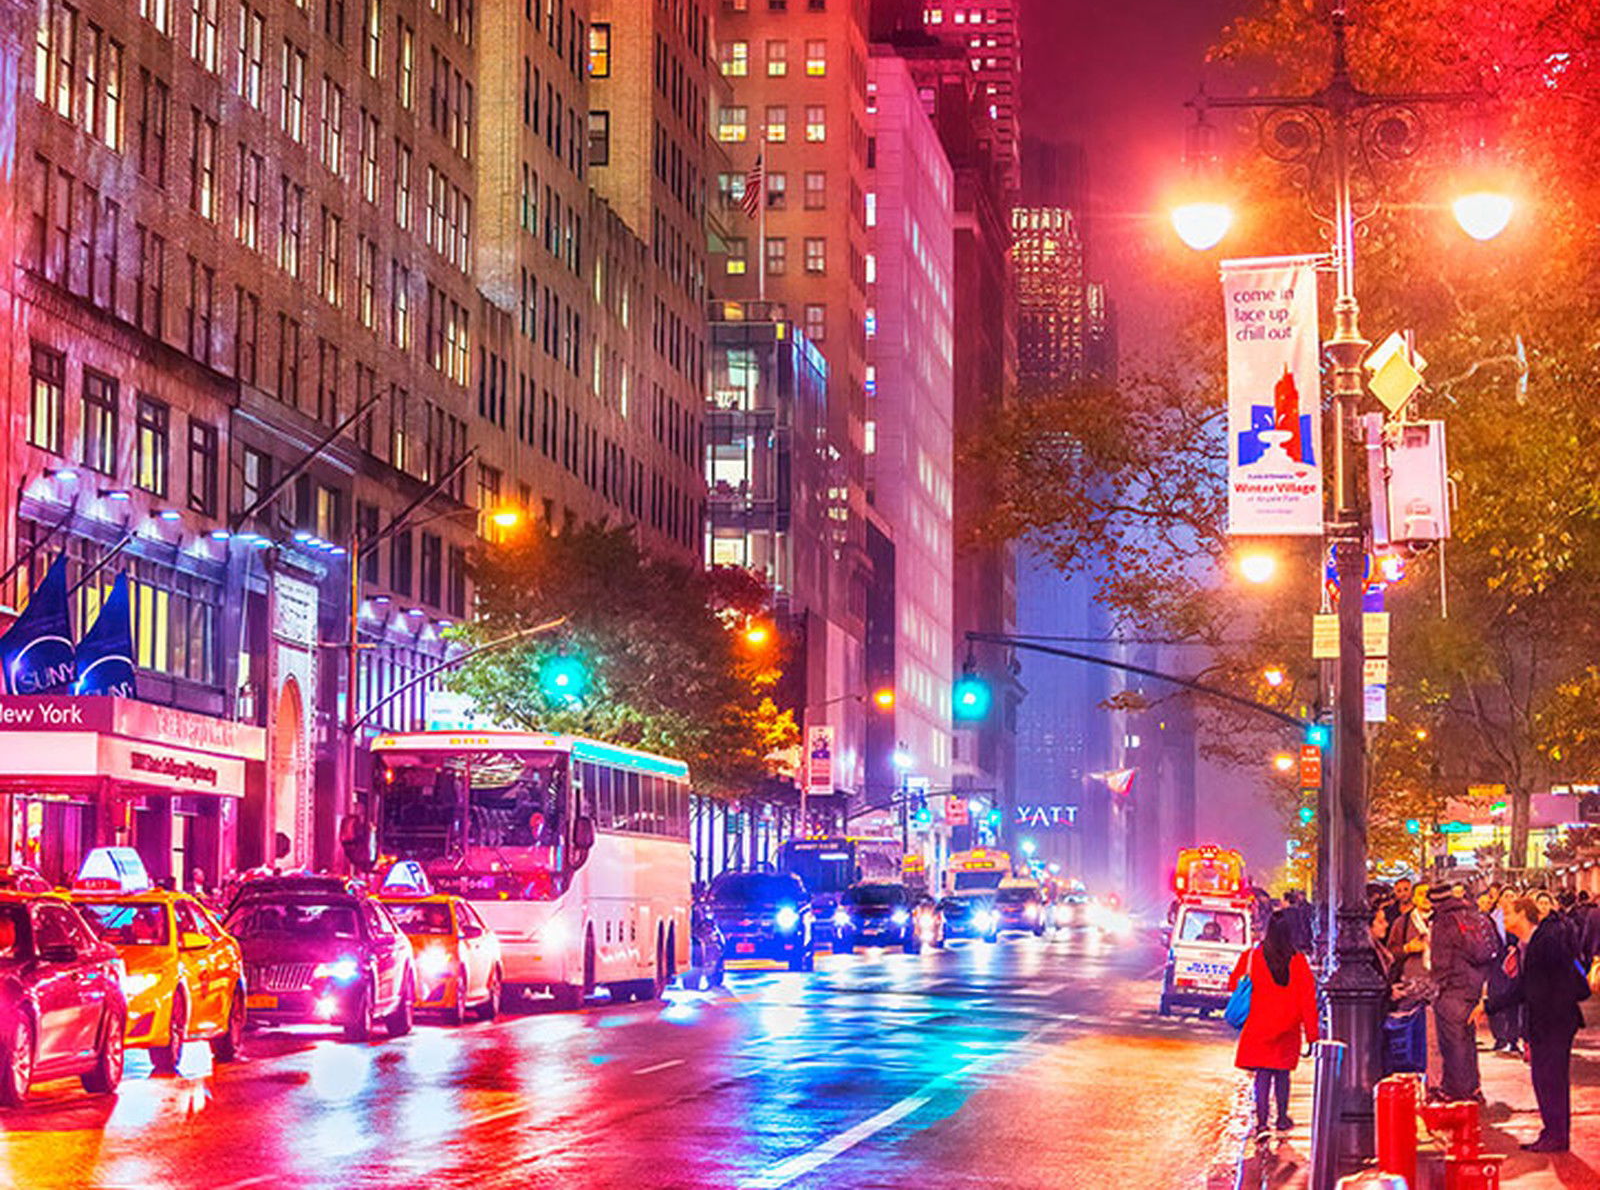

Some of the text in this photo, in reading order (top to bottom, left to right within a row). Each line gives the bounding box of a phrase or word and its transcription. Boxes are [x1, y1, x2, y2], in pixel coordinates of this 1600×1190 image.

[1233, 290, 1275, 303] come
[1269, 309, 1288, 323] up
[1268, 327, 1291, 340] out
[1234, 483, 1316, 496] Winter Village
[20, 661, 75, 692] SUNY
[39, 703, 82, 724] York
